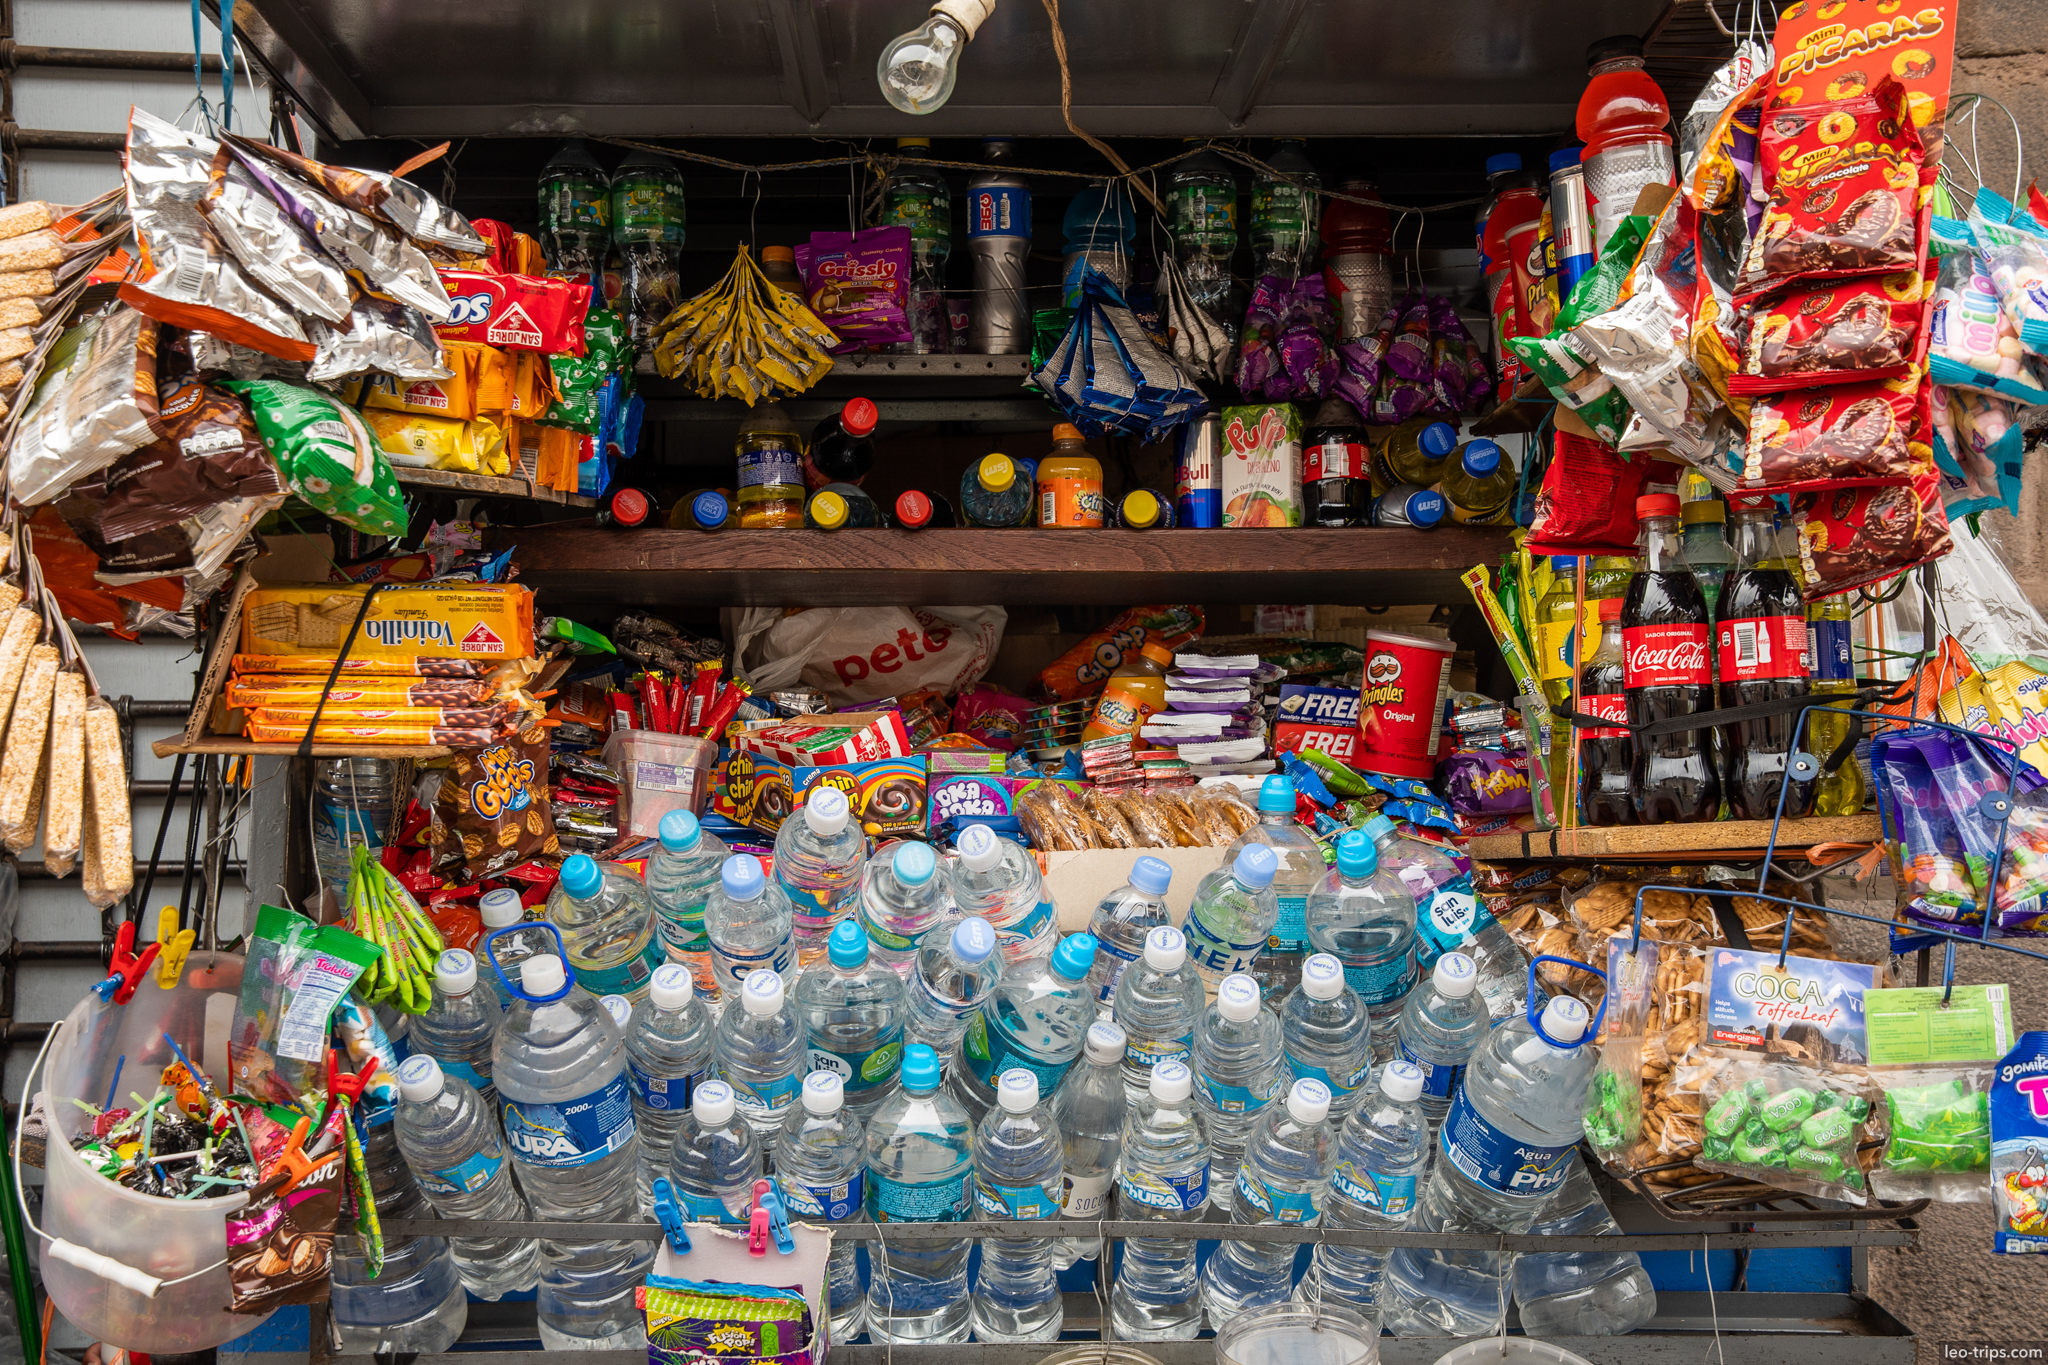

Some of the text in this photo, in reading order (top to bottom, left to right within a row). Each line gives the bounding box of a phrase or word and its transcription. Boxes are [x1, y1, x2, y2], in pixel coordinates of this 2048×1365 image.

[1806, 26, 1837, 45] Mini
[1777, 10, 1943, 84] PICARAS
[1801, 147, 1831, 164] Mini
[980, 193, 993, 230] 360
[818, 258, 897, 280] Grissly
[431, 293, 493, 325] SO
[489, 331, 542, 346] SAN JORGE
[168, 396, 187, 408] sabor
[404, 394, 448, 408] SAN JORGE
[1225, 407, 1287, 460] Pulp
[141, 459, 163, 472] chocolate
[1174, 462, 1213, 480] dBull
[1247, 460, 1281, 474] DURAZNO
[702, 507, 718, 516] KOLA
[704, 502, 719, 510] INCA
[394, 609, 429, 619] Familiar
[365, 620, 456, 646] Vainilla
[461, 643, 503, 652] SAN JORGE
[1077, 625, 1146, 685] CHOMP
[1631, 641, 1706, 673] Coca-Cola
[1361, 682, 1405, 713] Pringles
[1383, 709, 1416, 723] Original
[729, 753, 754, 777] chin
[782, 773, 790, 787] 12
[802, 768, 821, 787] crema
[729, 776, 754, 799] chin
[934, 782, 980, 807] OKA
[1434, 896, 1459, 917] san
[1441, 908, 1465, 927] luis
[316, 957, 353, 978] Trululu
[1735, 972, 1824, 1006] COCA
[1715, 999, 1731, 1007] Helps
[1715, 1006, 1735, 1014] altitude
[1716, 1030, 1760, 1042] Energizer
[1732, 1026, 1756, 1035] Digestive
[813, 1052, 839, 1069] san
[1770, 1097, 1802, 1118] COCA
[1720, 1106, 1744, 1132] COCA
[508, 1129, 582, 1158] URA
[1814, 1124, 1847, 1144] COCA
[1514, 1147, 1552, 1160] Agua
[1799, 1149, 1832, 1166] COCA
[1509, 1162, 1572, 1189] PhU
[784, 1193, 823, 1216] URA
[974, 1186, 1010, 1216] URA
[237, 1208, 283, 1237] ALMENDRAS
